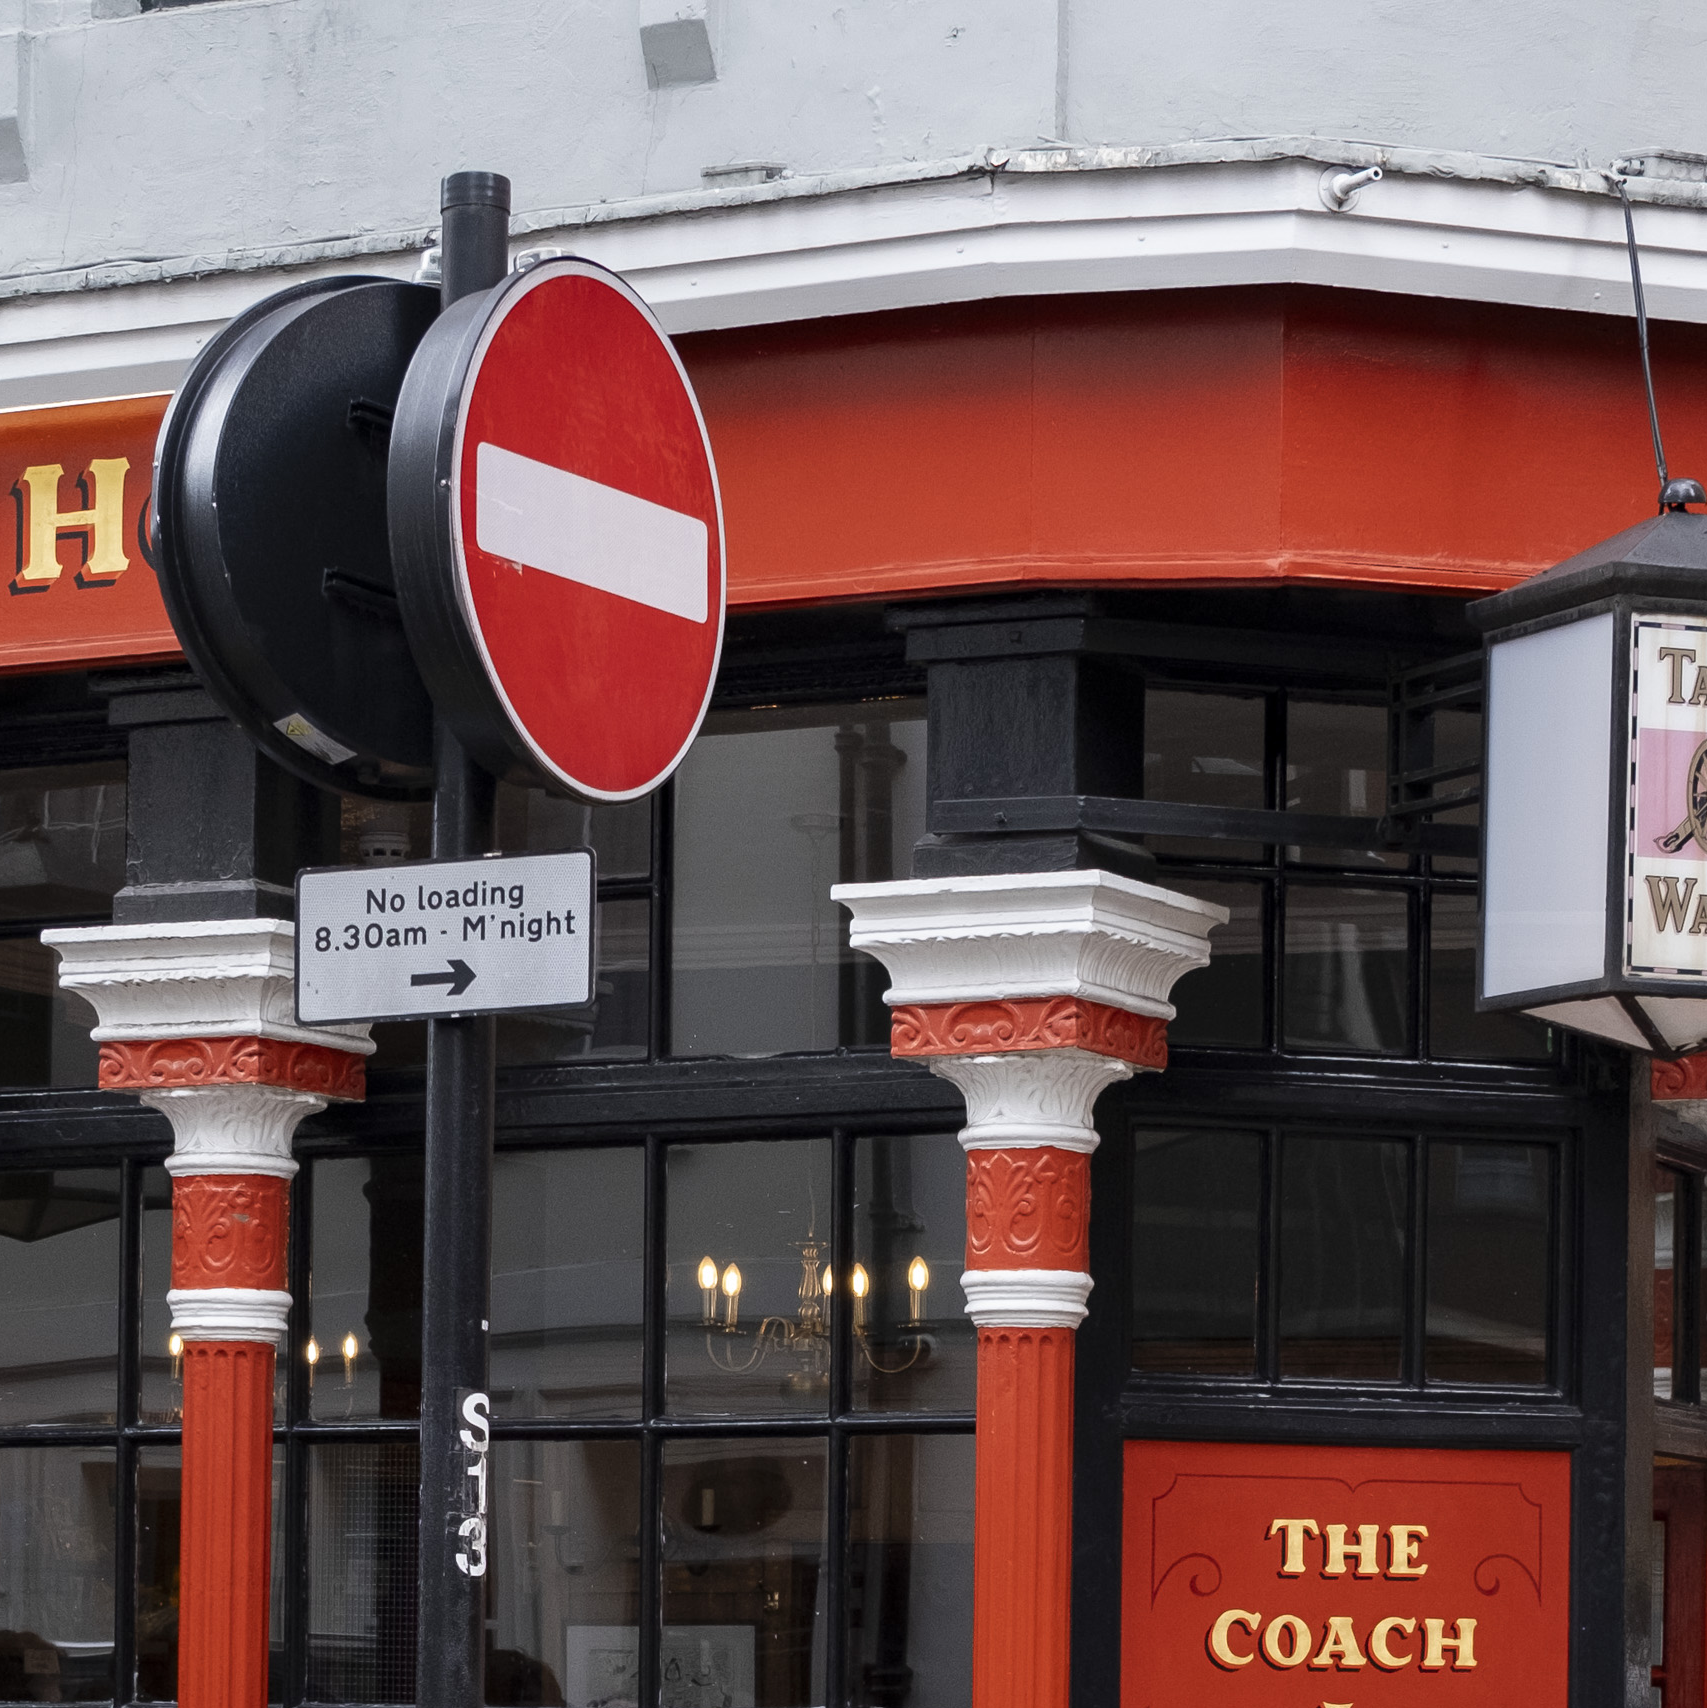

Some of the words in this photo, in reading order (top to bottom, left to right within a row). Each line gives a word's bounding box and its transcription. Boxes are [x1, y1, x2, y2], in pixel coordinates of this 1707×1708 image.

[366, 888, 406, 914] No
[418, 881, 524, 909] loading
[315, 922, 427, 952] 8.30am
[463, 909, 576, 942] M'night
[1266, 1518, 1429, 1578] THE
[1208, 1610, 1478, 1671] COACH
